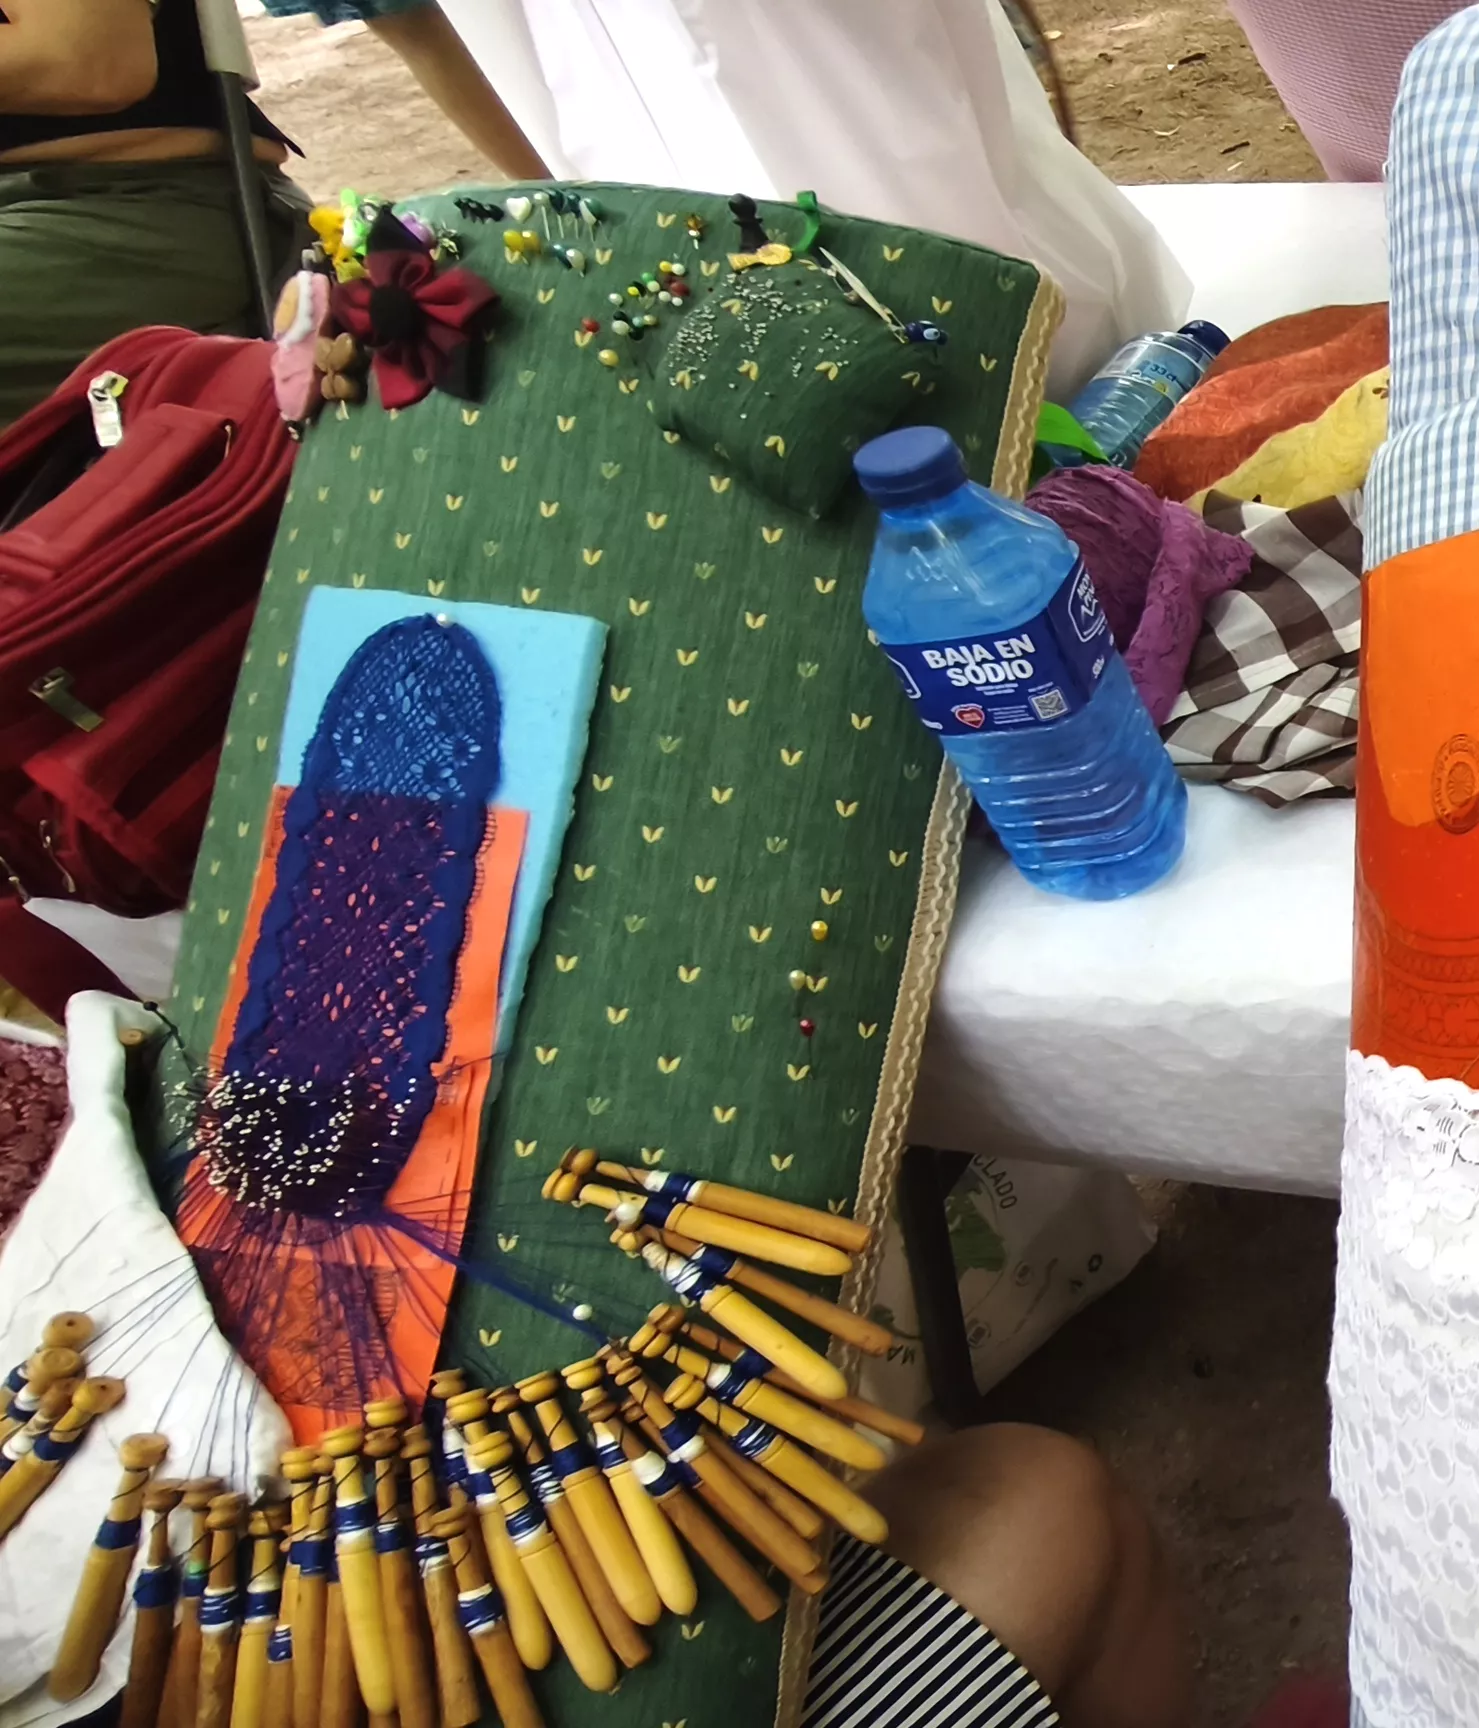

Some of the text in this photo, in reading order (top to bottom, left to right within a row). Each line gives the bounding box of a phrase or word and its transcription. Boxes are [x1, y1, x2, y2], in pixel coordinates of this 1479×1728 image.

[921, 633, 1036, 670] BAJA EN
[946, 659, 1034, 687] SODIO
